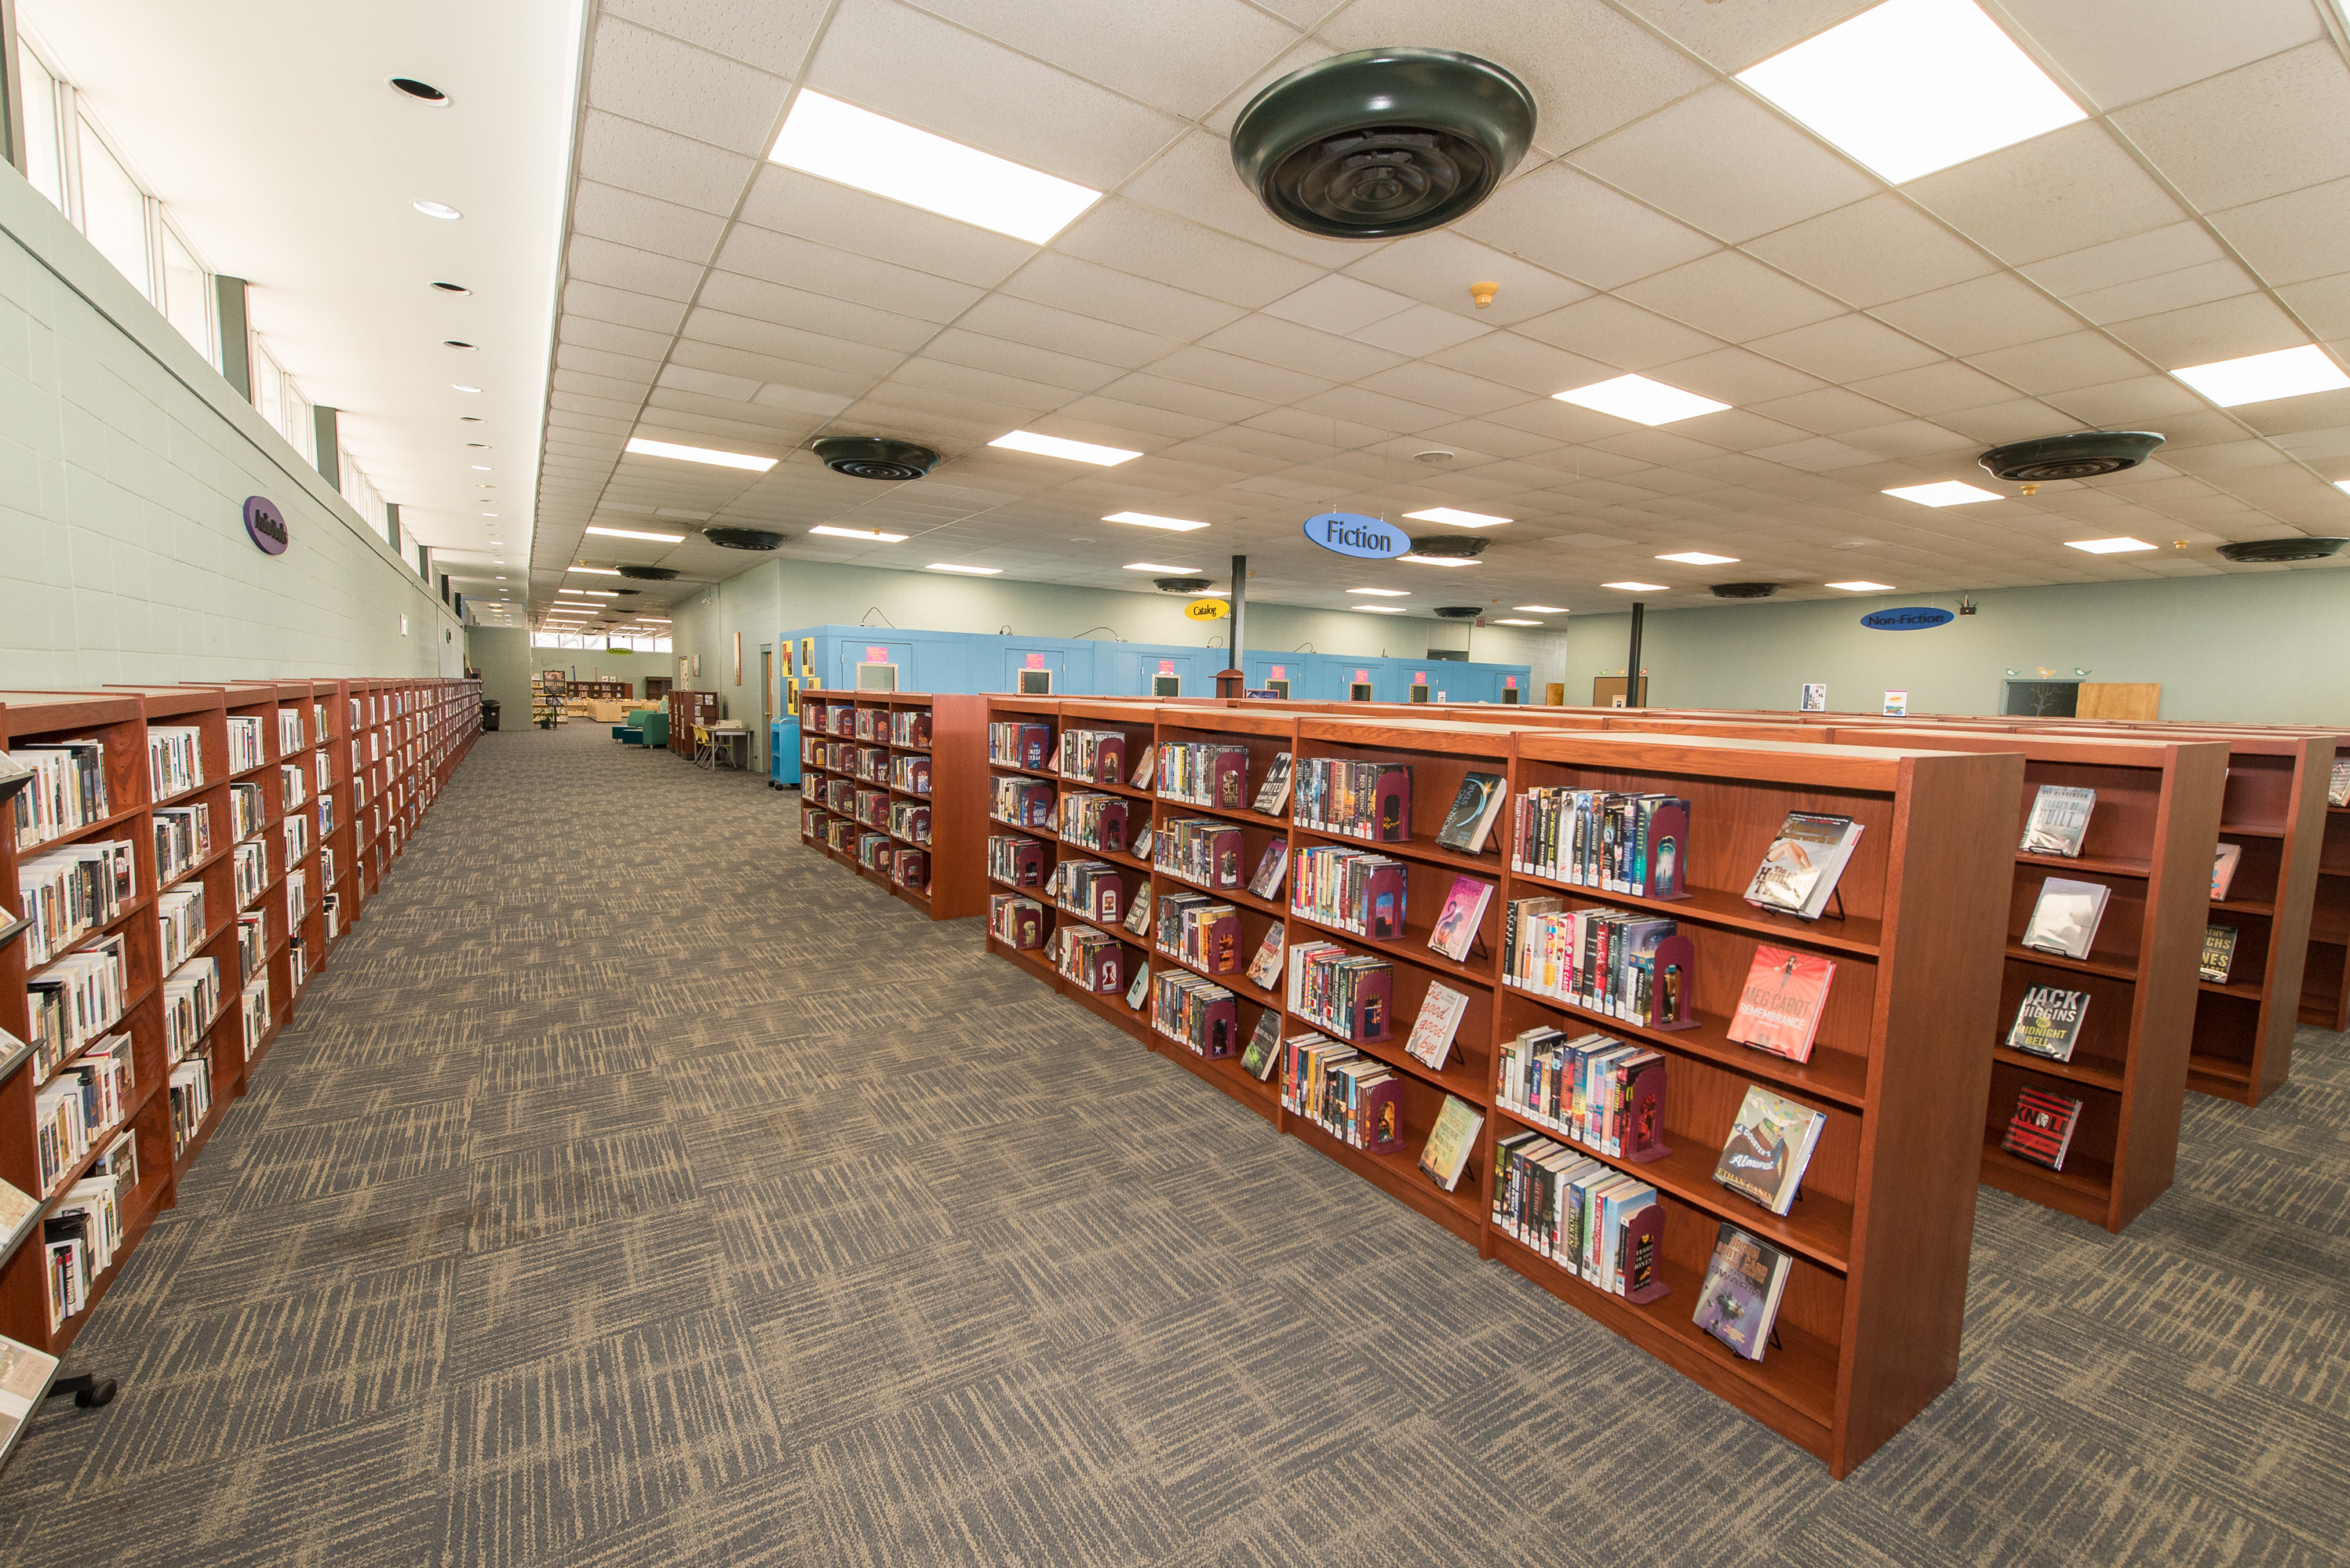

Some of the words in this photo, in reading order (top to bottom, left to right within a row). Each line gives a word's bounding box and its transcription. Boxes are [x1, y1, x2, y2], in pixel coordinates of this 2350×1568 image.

[1328, 519, 1392, 552] Fiction
[1193, 605, 1216, 617] Catalog
[1868, 613, 1944, 626] Non-Fiction
[1461, 784, 1478, 806] STAR
[2043, 800, 2068, 809] TRACES
[2070, 802, 2079, 810] OF
[1440, 789, 1466, 836] MORNING
[2204, 937, 2232, 949] CHS
[2202, 951, 2229, 966] NES
[1426, 983, 1442, 1000] the
[1743, 986, 1770, 1006] MEG
[1771, 993, 1812, 1017] CABOT
[2026, 988, 2082, 1010] JACK
[1417, 1002, 1450, 1020] good
[1739, 1003, 1805, 1031] REMEMBRANCE
[2024, 1006, 2077, 1022] HIGGINS
[2016, 1025, 2068, 1039] MIDNIGHT
[2025, 1036, 2049, 1047] BELL
[1419, 1035, 1437, 1059] bye
[1574, 1056, 1583, 1083] EMPIRE
[1572, 1086, 1583, 1111] RISING
[1439, 1122, 1459, 1141] HOUSE
[1434, 1133, 1454, 1153] RISING
[1434, 1144, 1447, 1158] SUN
[1743, 1129, 1771, 1158] DOUBTER'S
[1729, 1155, 1774, 1170] Almanac
[1718, 1168, 1745, 1187] ETHAN
[1747, 1183, 1773, 1201] CANIN
[1716, 1241, 1743, 1265] SCOTT
[1729, 1236, 1761, 1261] ORSON
[1711, 1265, 1761, 1298] SWARM
